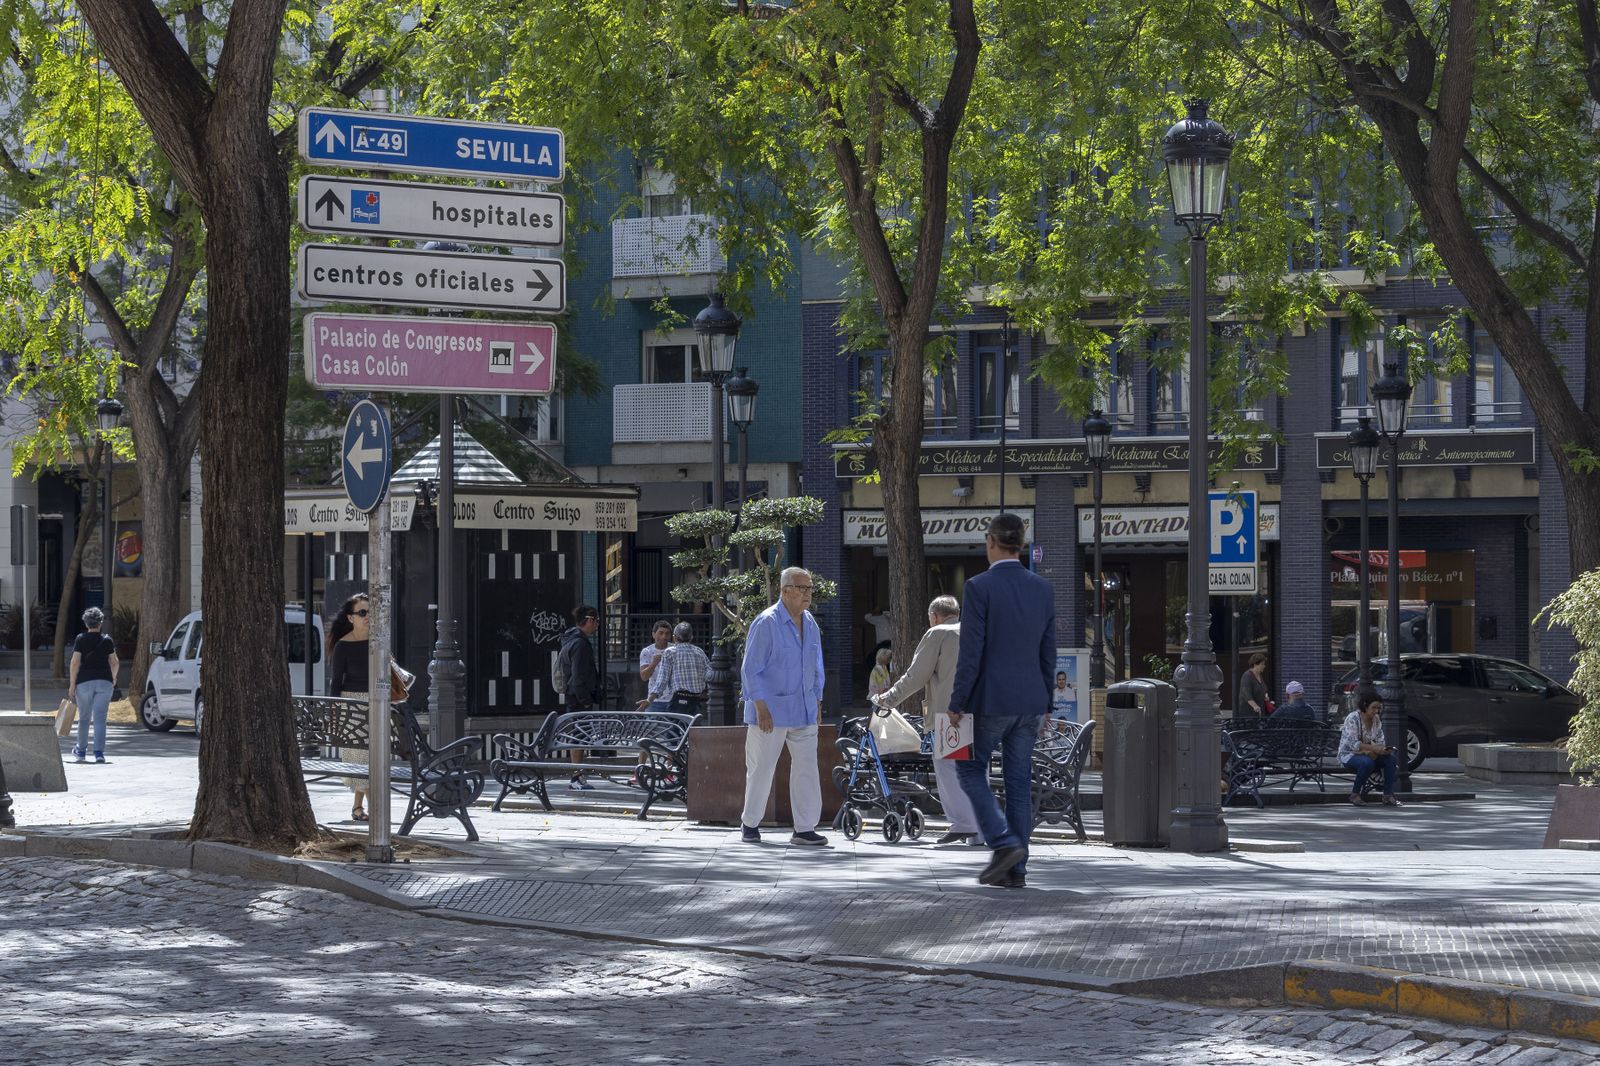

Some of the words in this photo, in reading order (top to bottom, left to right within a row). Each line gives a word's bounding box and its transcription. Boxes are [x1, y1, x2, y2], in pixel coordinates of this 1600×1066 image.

[356, 131, 403, 150] A-49
[456, 137, 553, 166] SEVILLA
[432, 201, 554, 228] hospitales
[313, 265, 404, 287] centros
[415, 268, 515, 293] oficiales
[320, 326, 377, 349] Palacio
[382, 330, 400, 350] de
[405, 329, 483, 355] Congresos
[321, 354, 360, 375] Casa
[365, 355, 409, 377] Colón
[933, 449, 981, 464] Médico
[983, 449, 998, 464] de
[1004, 447, 1084, 467] Especialidades
[1106, 445, 1159, 461] Medicina
[1162, 445, 1216, 461] Esta
[1435, 448, 1516, 463] Antienvejecimiento
[309, 503, 339, 523] Centro
[345, 503, 368, 526] Suiz
[493, 499, 535, 521] Centro
[543, 500, 581, 526] Suizo
[595, 501, 605, 514] 959
[606, 502, 615, 514] 281
[1083, 512, 1122, 521] D'enú
[596, 516, 605, 529] 959
[606, 516, 616, 529] 254
[617, 517, 627, 529] 142
[857, 516, 992, 539] MODITOS
[1092, 516, 1190, 538] MONTADI
[1210, 499, 1244, 555] P
[1210, 574, 1227, 586] CASA
[1230, 574, 1251, 585] COLON
[1368, 571, 1409, 584] uinro
[1412, 570, 1442, 584] Báez,
